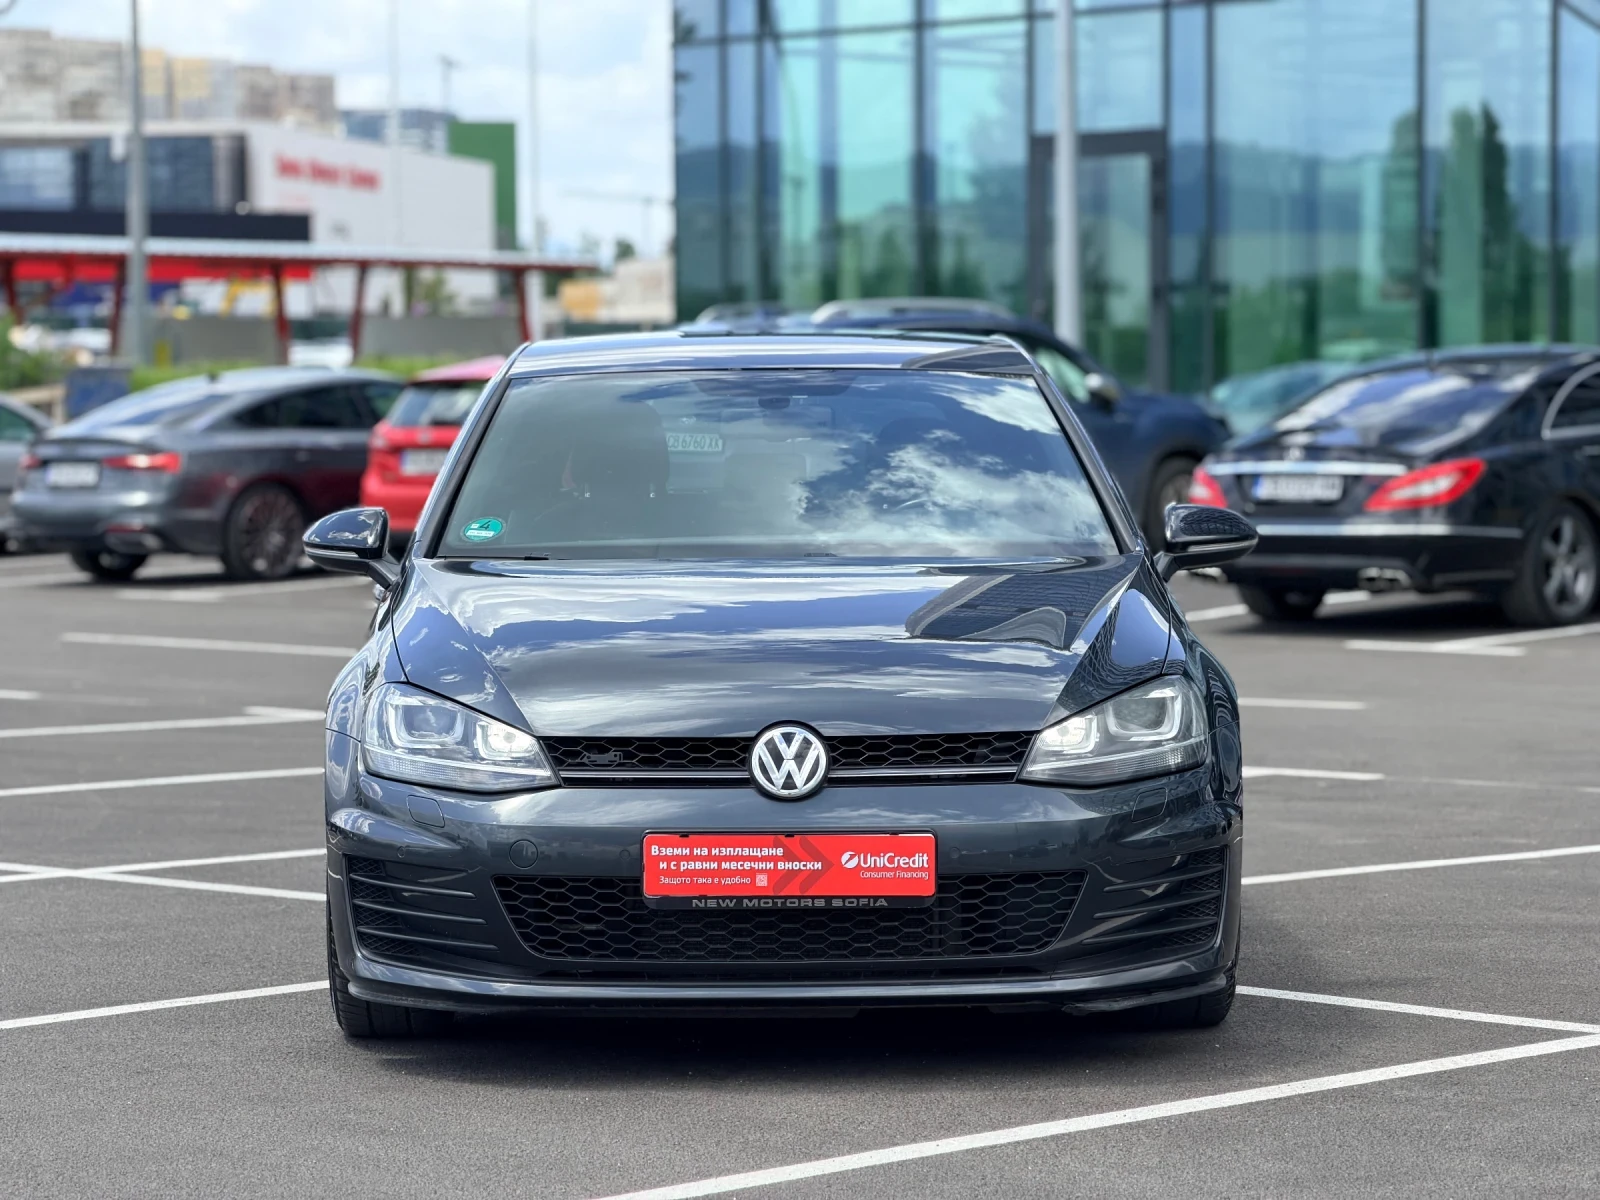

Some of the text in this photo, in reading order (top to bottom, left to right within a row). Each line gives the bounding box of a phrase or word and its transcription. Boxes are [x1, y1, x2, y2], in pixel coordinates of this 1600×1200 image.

[480, 520, 491, 530] 4
[754, 728, 824, 795] VW
[651, 844, 784, 858] Вземи на изплащане
[860, 851, 929, 868] UniCredit
[659, 861, 822, 872] и с равни месечни вноски
[659, 875, 691, 885] Защото
[721, 875, 751, 886] удобно
[860, 870, 929, 880] Consumer Financing
[692, 898, 888, 908] NEW MOTORS SOFIA
